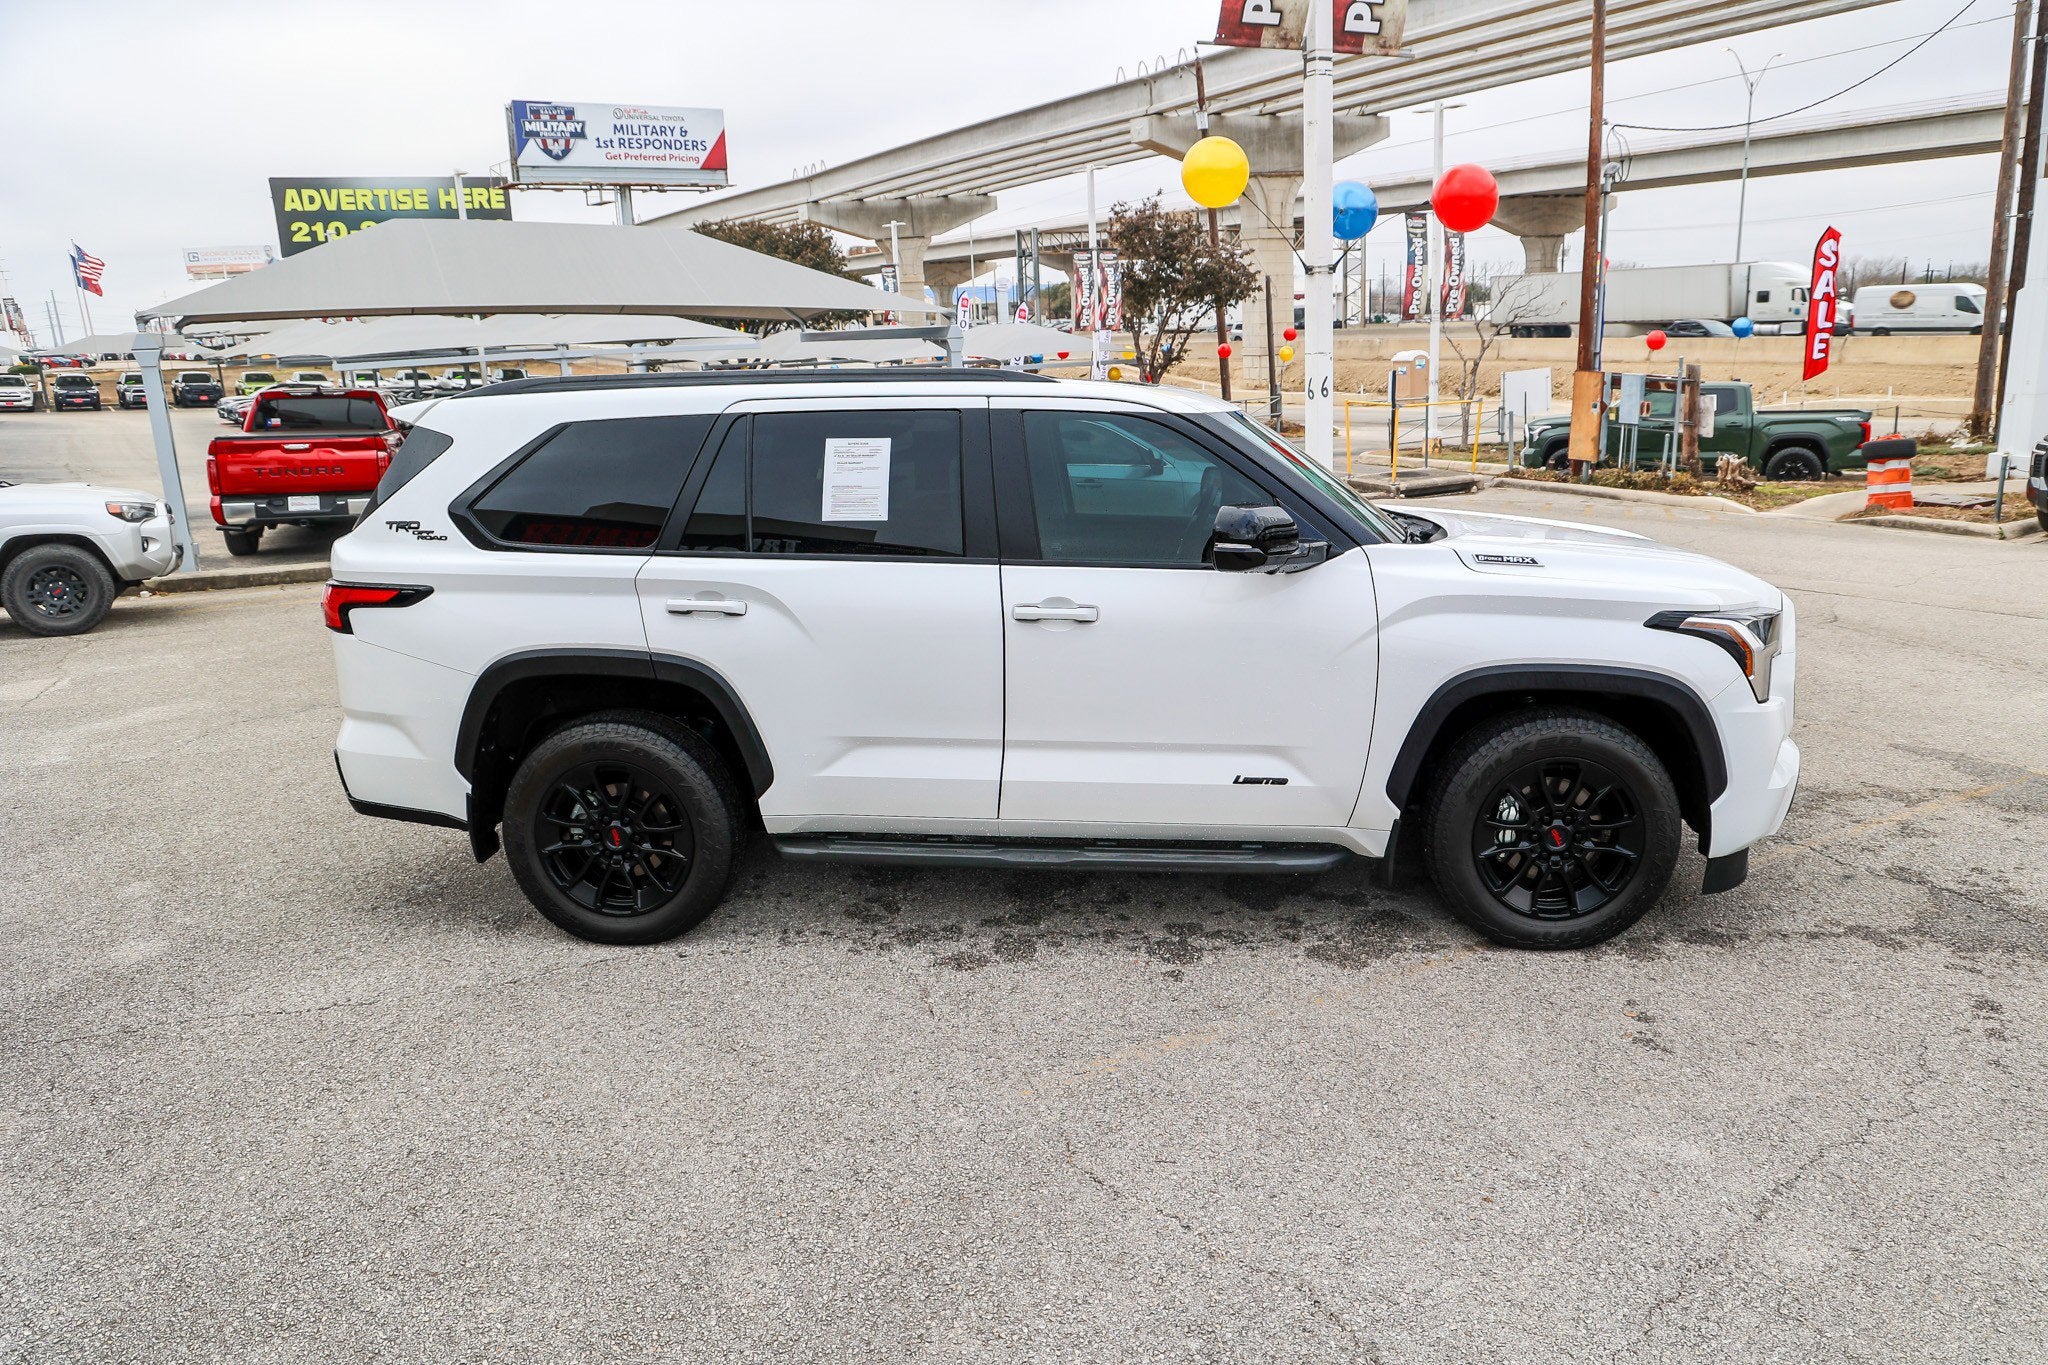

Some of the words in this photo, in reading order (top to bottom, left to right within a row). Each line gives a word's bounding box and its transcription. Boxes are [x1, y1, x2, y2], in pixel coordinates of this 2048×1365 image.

[524, 120, 583, 133] MILITARY
[613, 124, 676, 137] MILITARY
[679, 126, 688, 138] &
[594, 137, 615, 149] 1st
[619, 138, 708, 152] RESPONDERS
[605, 152, 622, 161] Get
[624, 152, 667, 162] Preferred
[669, 154, 700, 164] Pricing
[284, 188, 429, 212] ADVERTISE
[438, 187, 506, 210] HERE
[1803, 238, 1838, 361] SALE
[252, 467, 345, 477] TUNDRA
[385, 520, 421, 532] TRD
[1503, 556, 1533, 564] MAX
